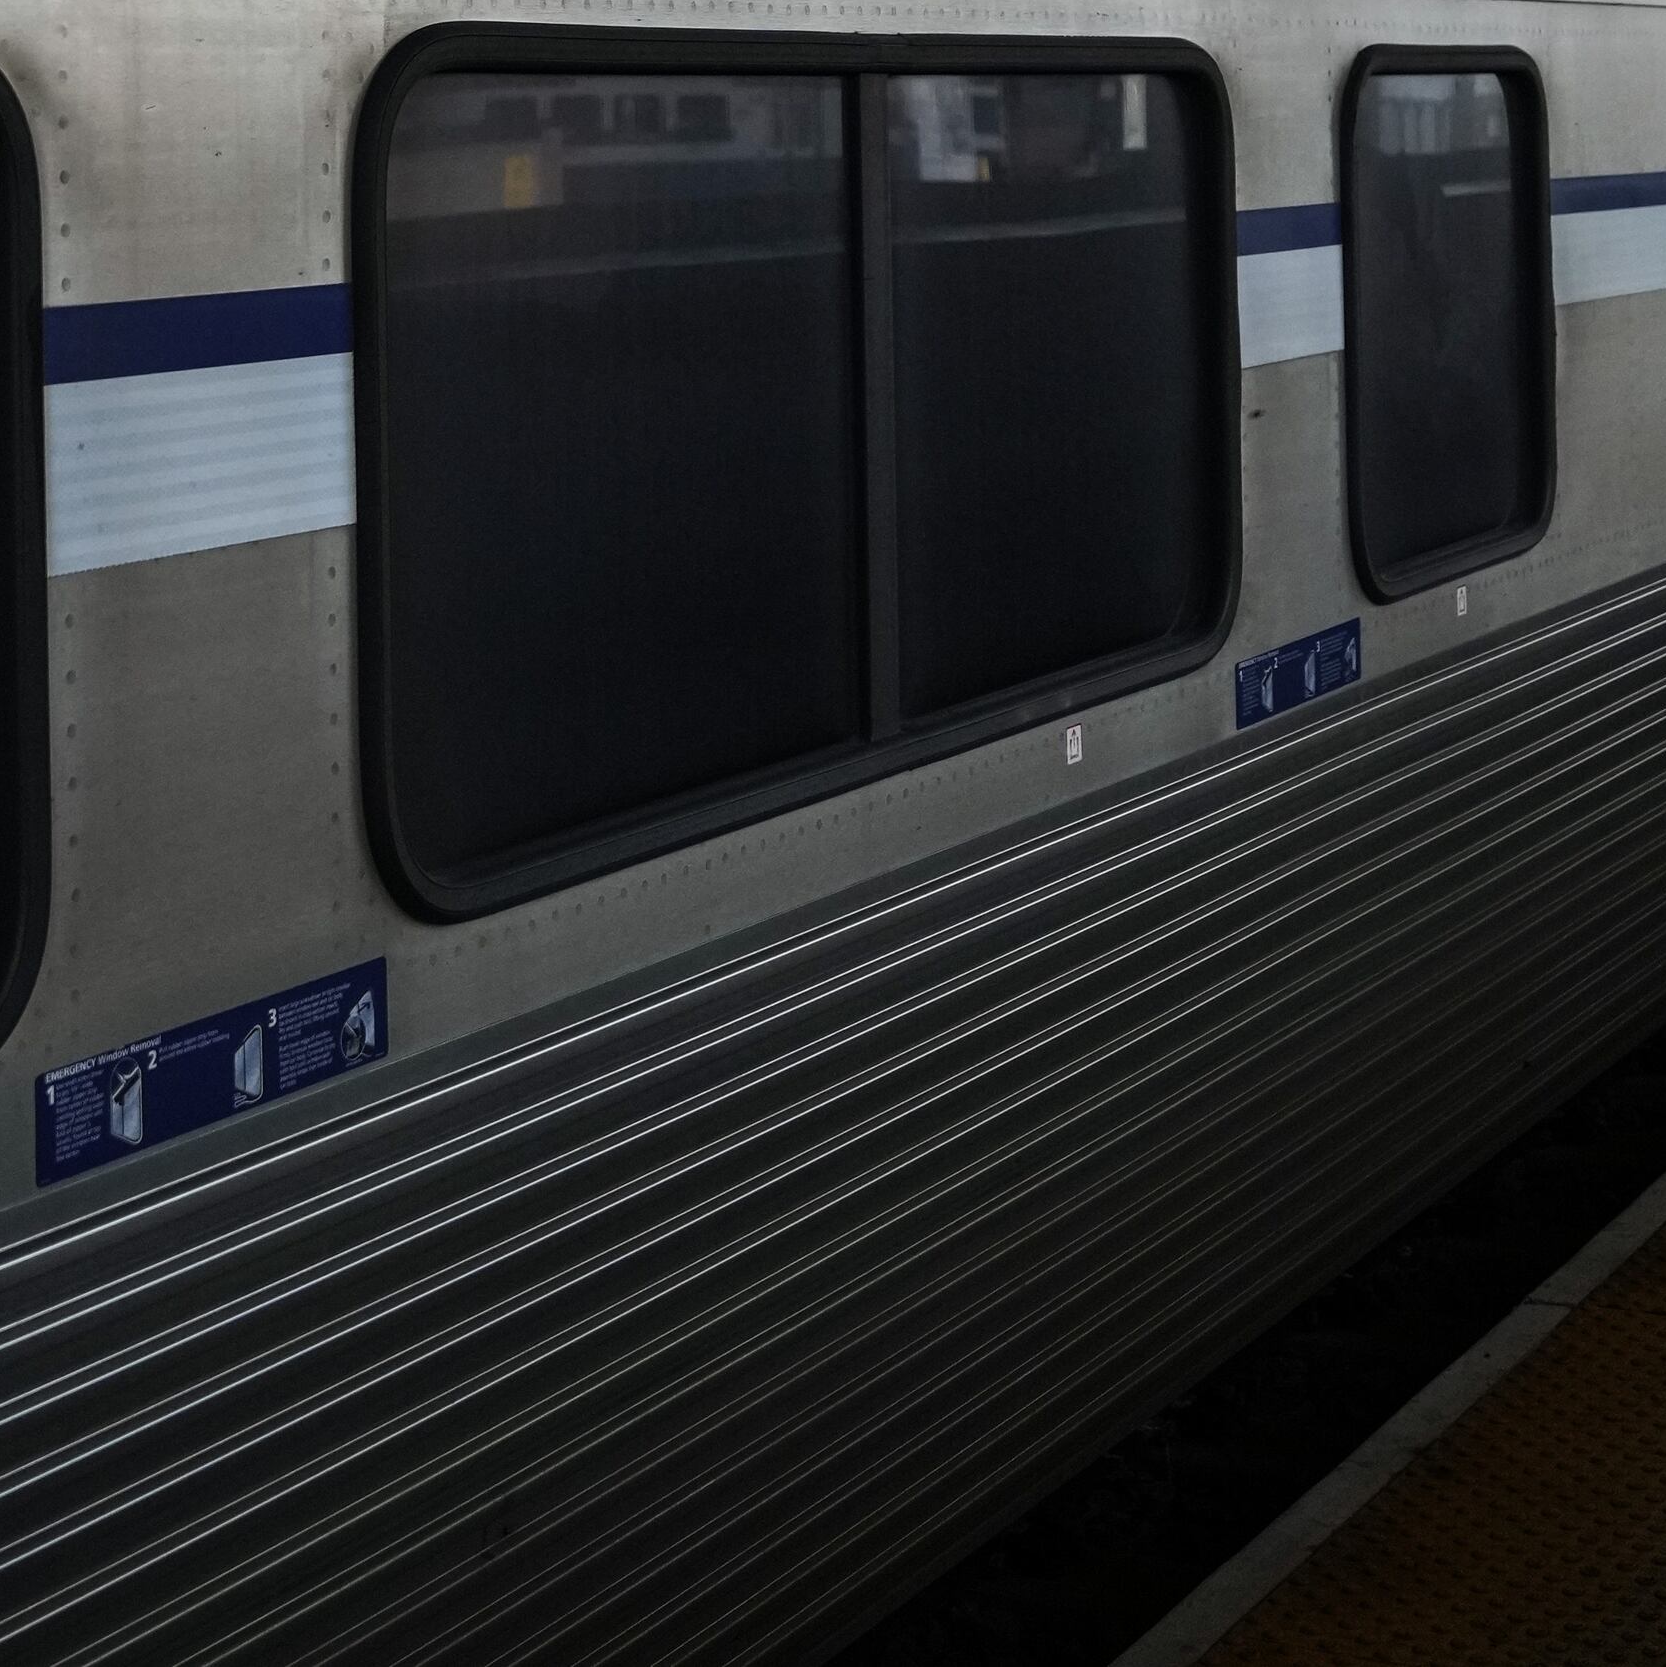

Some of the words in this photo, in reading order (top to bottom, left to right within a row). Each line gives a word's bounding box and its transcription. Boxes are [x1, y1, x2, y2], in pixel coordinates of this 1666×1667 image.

[268, 1008, 277, 1028] 3
[45, 1057, 97, 1084] EMERGENCY
[99, 1047, 130, 1065] Window
[130, 1035, 162, 1053] Removal
[147, 1050, 157, 1070] 2
[47, 1085, 55, 1106] 1
